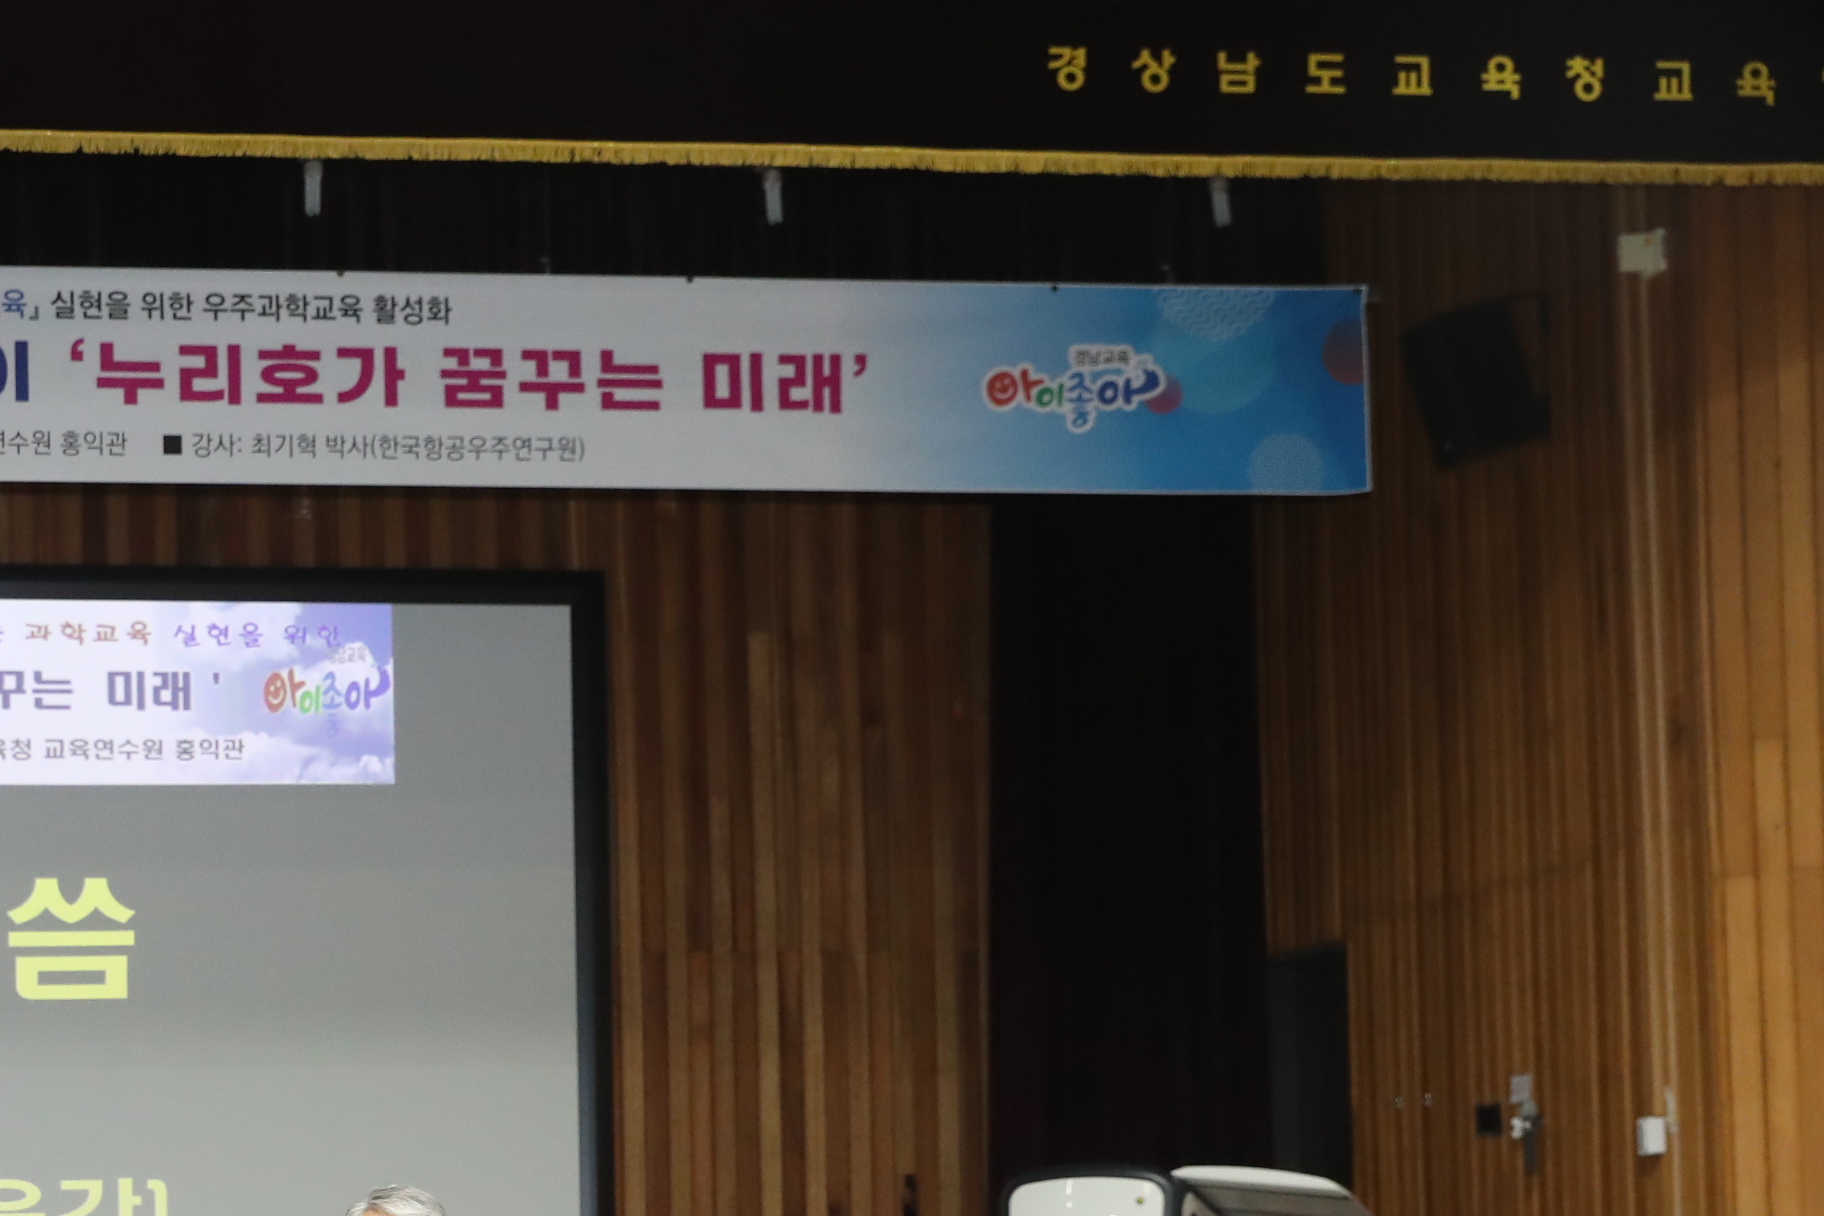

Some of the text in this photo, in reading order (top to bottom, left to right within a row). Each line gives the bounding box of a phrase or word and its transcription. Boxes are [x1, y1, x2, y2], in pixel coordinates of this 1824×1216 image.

[51, 290, 131, 320] 실현을
[141, 292, 194, 321] 위한
[203, 293, 363, 324] 우주과학교육
[373, 295, 452, 326] 활성화
[70, 338, 405, 407] ‘누리호가
[440, 347, 663, 411] 꿈꾸는
[702, 352, 867, 414] 미래’
[60, 430, 128, 456] 홍익관
[192, 433, 585, 462] 강사: 최기혁 박사(한국항공우주연구원)
[25, 621, 151, 646] 과학교육
[174, 622, 263, 648] 실현을
[284, 624, 341, 648] 위한
[44, 739, 163, 760] 교육연수원
[175, 735, 245, 761] 홍익관
